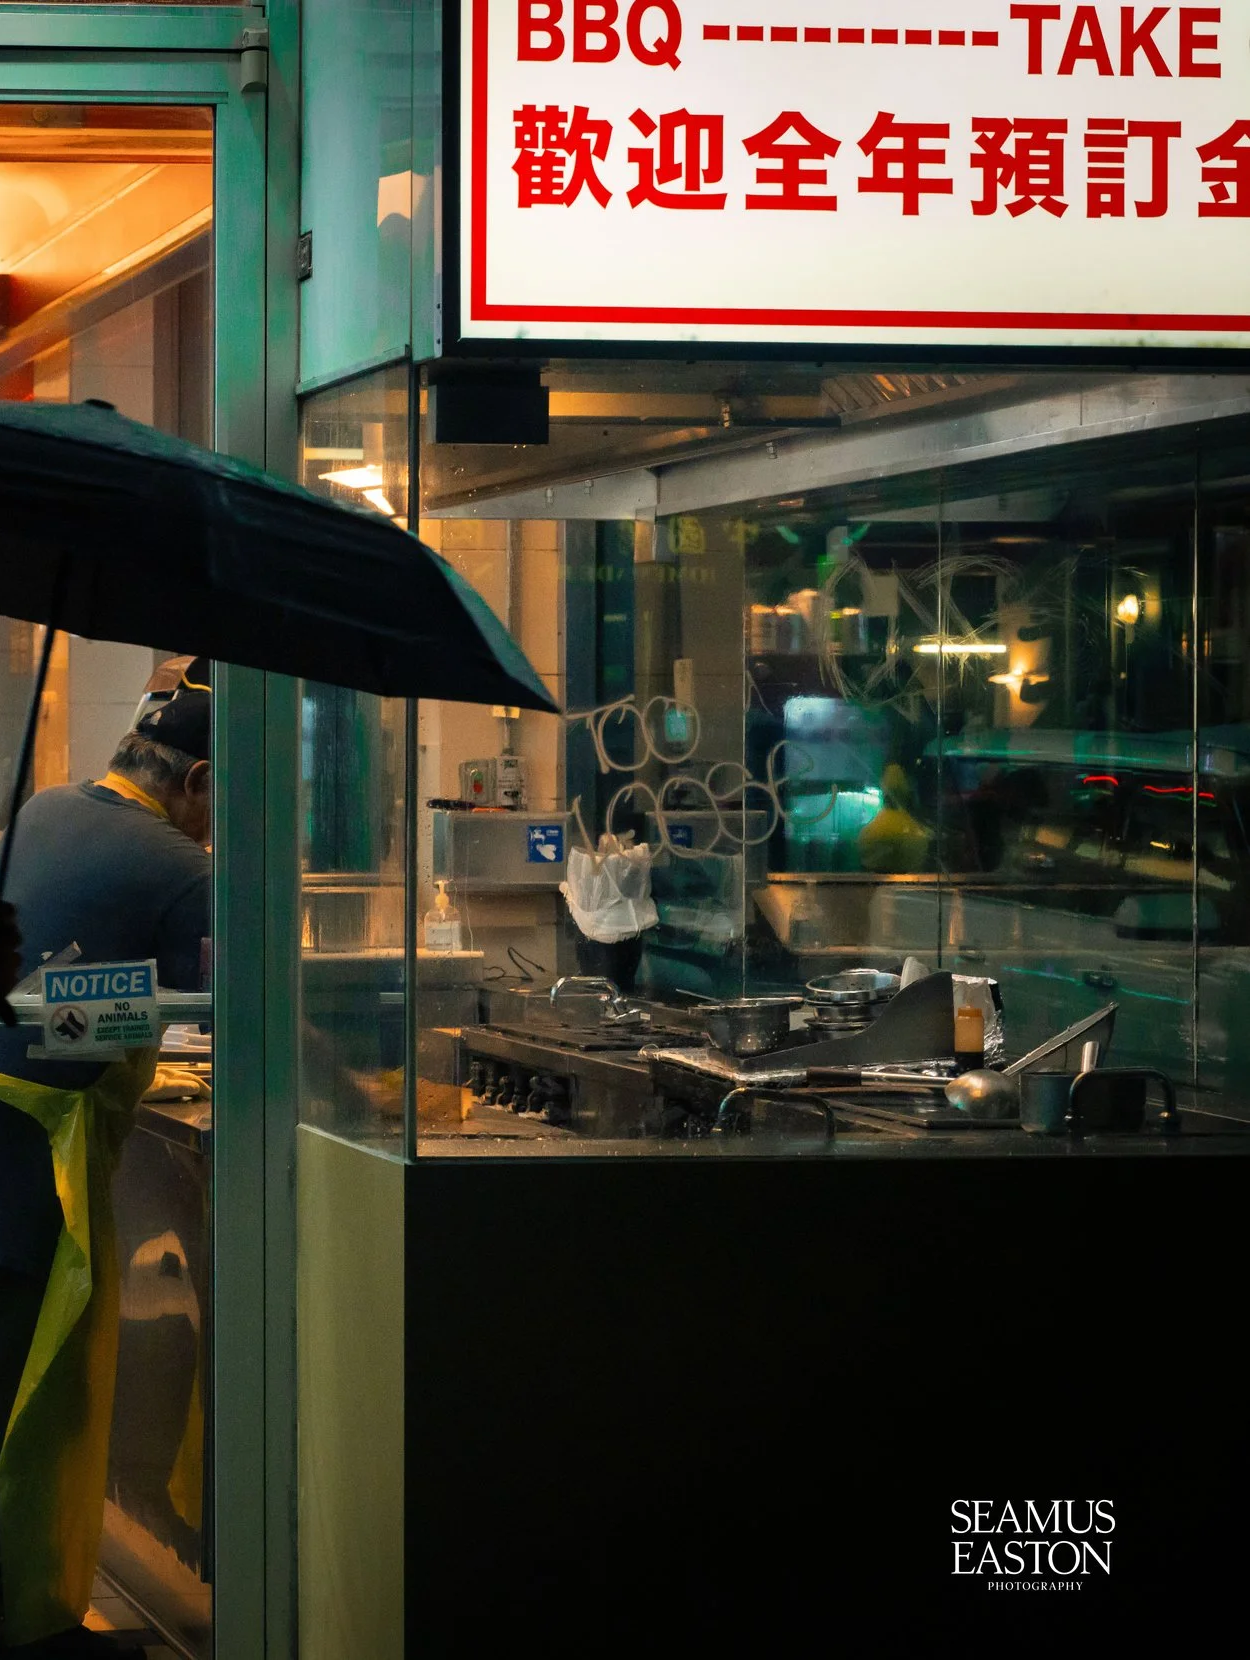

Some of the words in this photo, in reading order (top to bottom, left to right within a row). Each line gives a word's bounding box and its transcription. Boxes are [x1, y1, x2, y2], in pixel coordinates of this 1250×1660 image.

[517, 0, 682, 71] BBQ
[1010, 3, 1221, 78] TAKE
[51, 970, 147, 998] NOTICE
[114, 1001, 130, 1011] NO
[97, 1011, 148, 1024] ANIMALS
